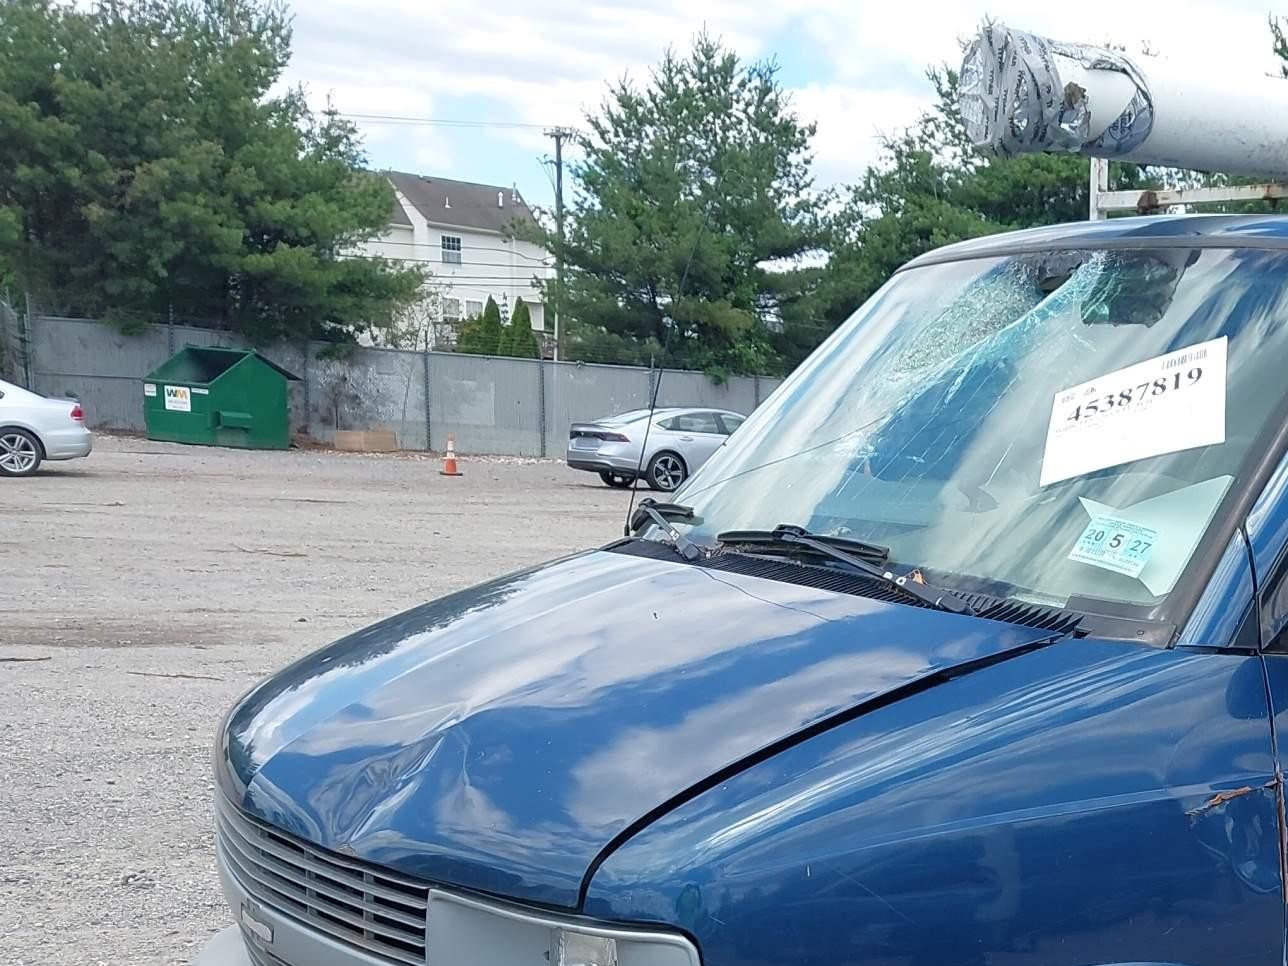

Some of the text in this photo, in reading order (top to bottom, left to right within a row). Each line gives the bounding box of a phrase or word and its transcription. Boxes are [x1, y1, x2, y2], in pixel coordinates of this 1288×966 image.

[166, 388, 188, 399] WM
[1067, 367, 1203, 422] 45387819
[1084, 528, 1152, 554] 20 5 27
